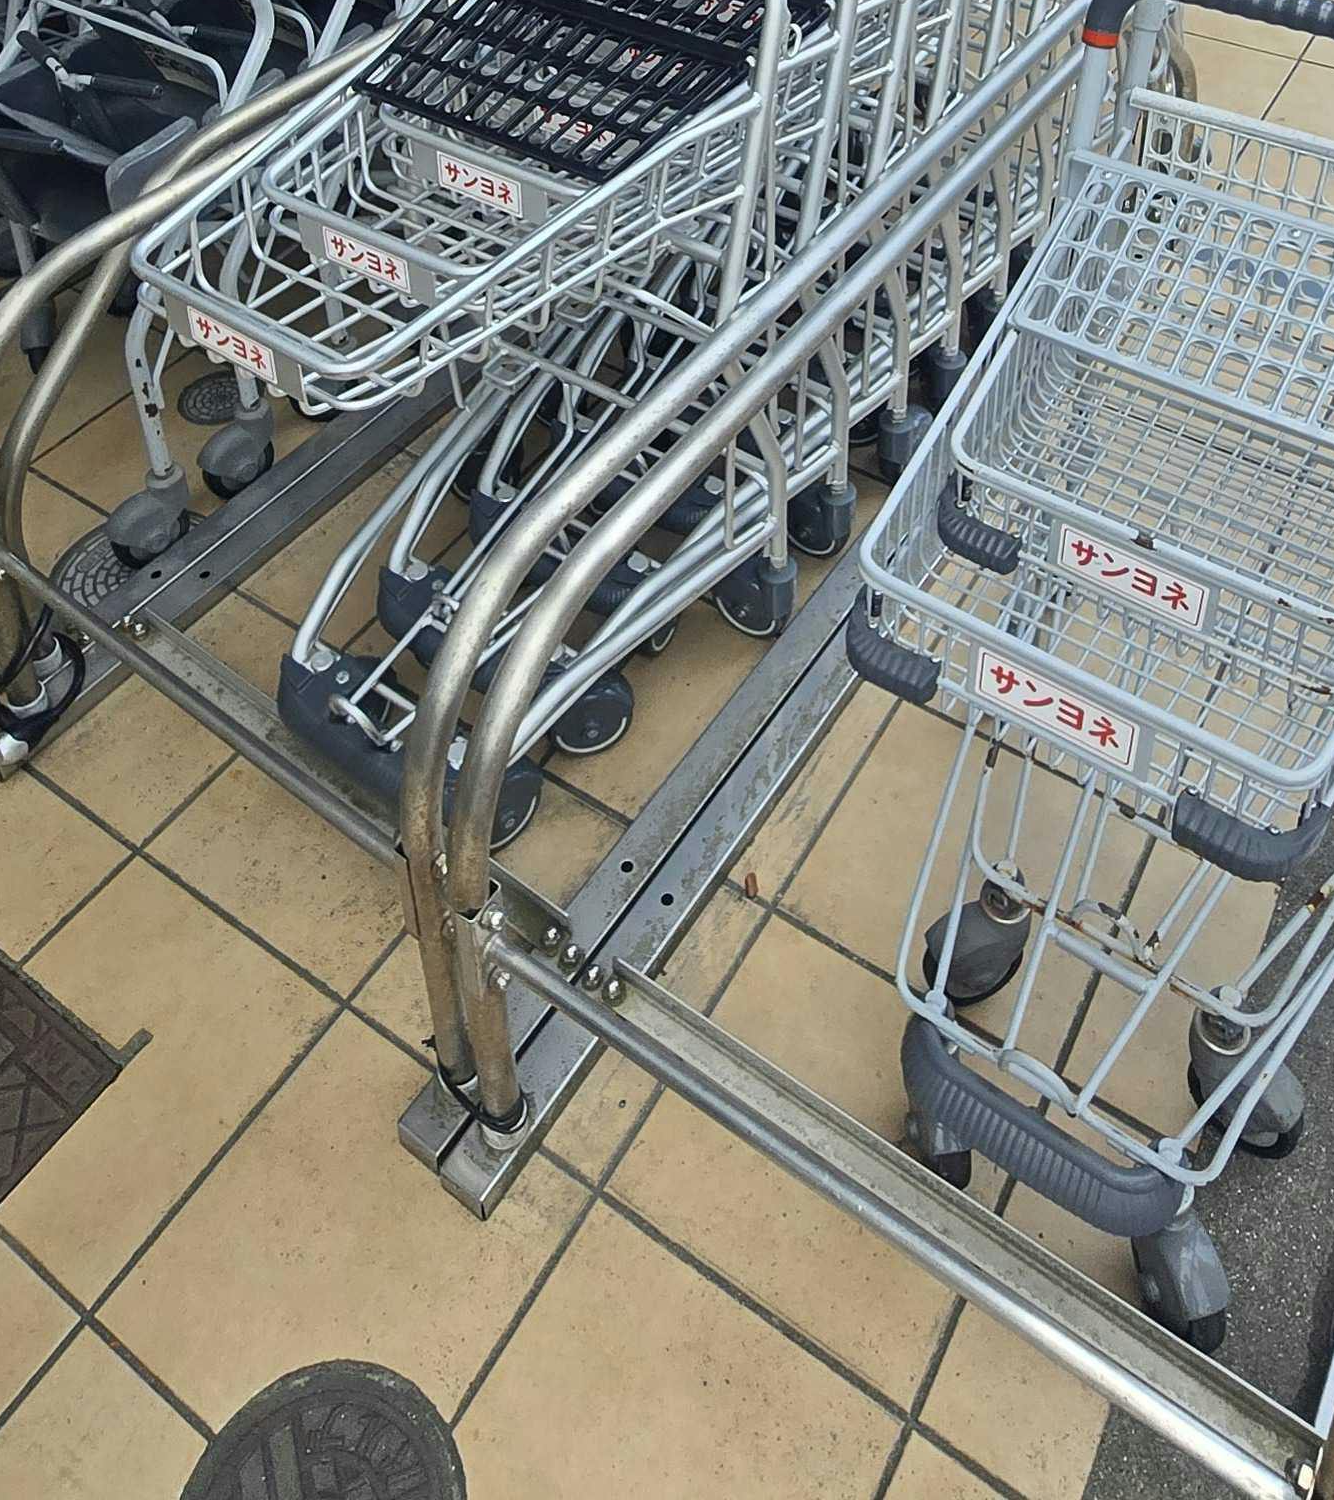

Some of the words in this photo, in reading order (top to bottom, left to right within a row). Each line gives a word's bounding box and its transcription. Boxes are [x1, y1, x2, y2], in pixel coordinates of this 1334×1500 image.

[444, 163, 514, 205] サンヨネ
[331, 235, 401, 281] サンヨネ
[196, 317, 267, 371] サンヨネ
[1070, 540, 1190, 611] サンヨネ
[990, 665, 1120, 749] サンヨネ
